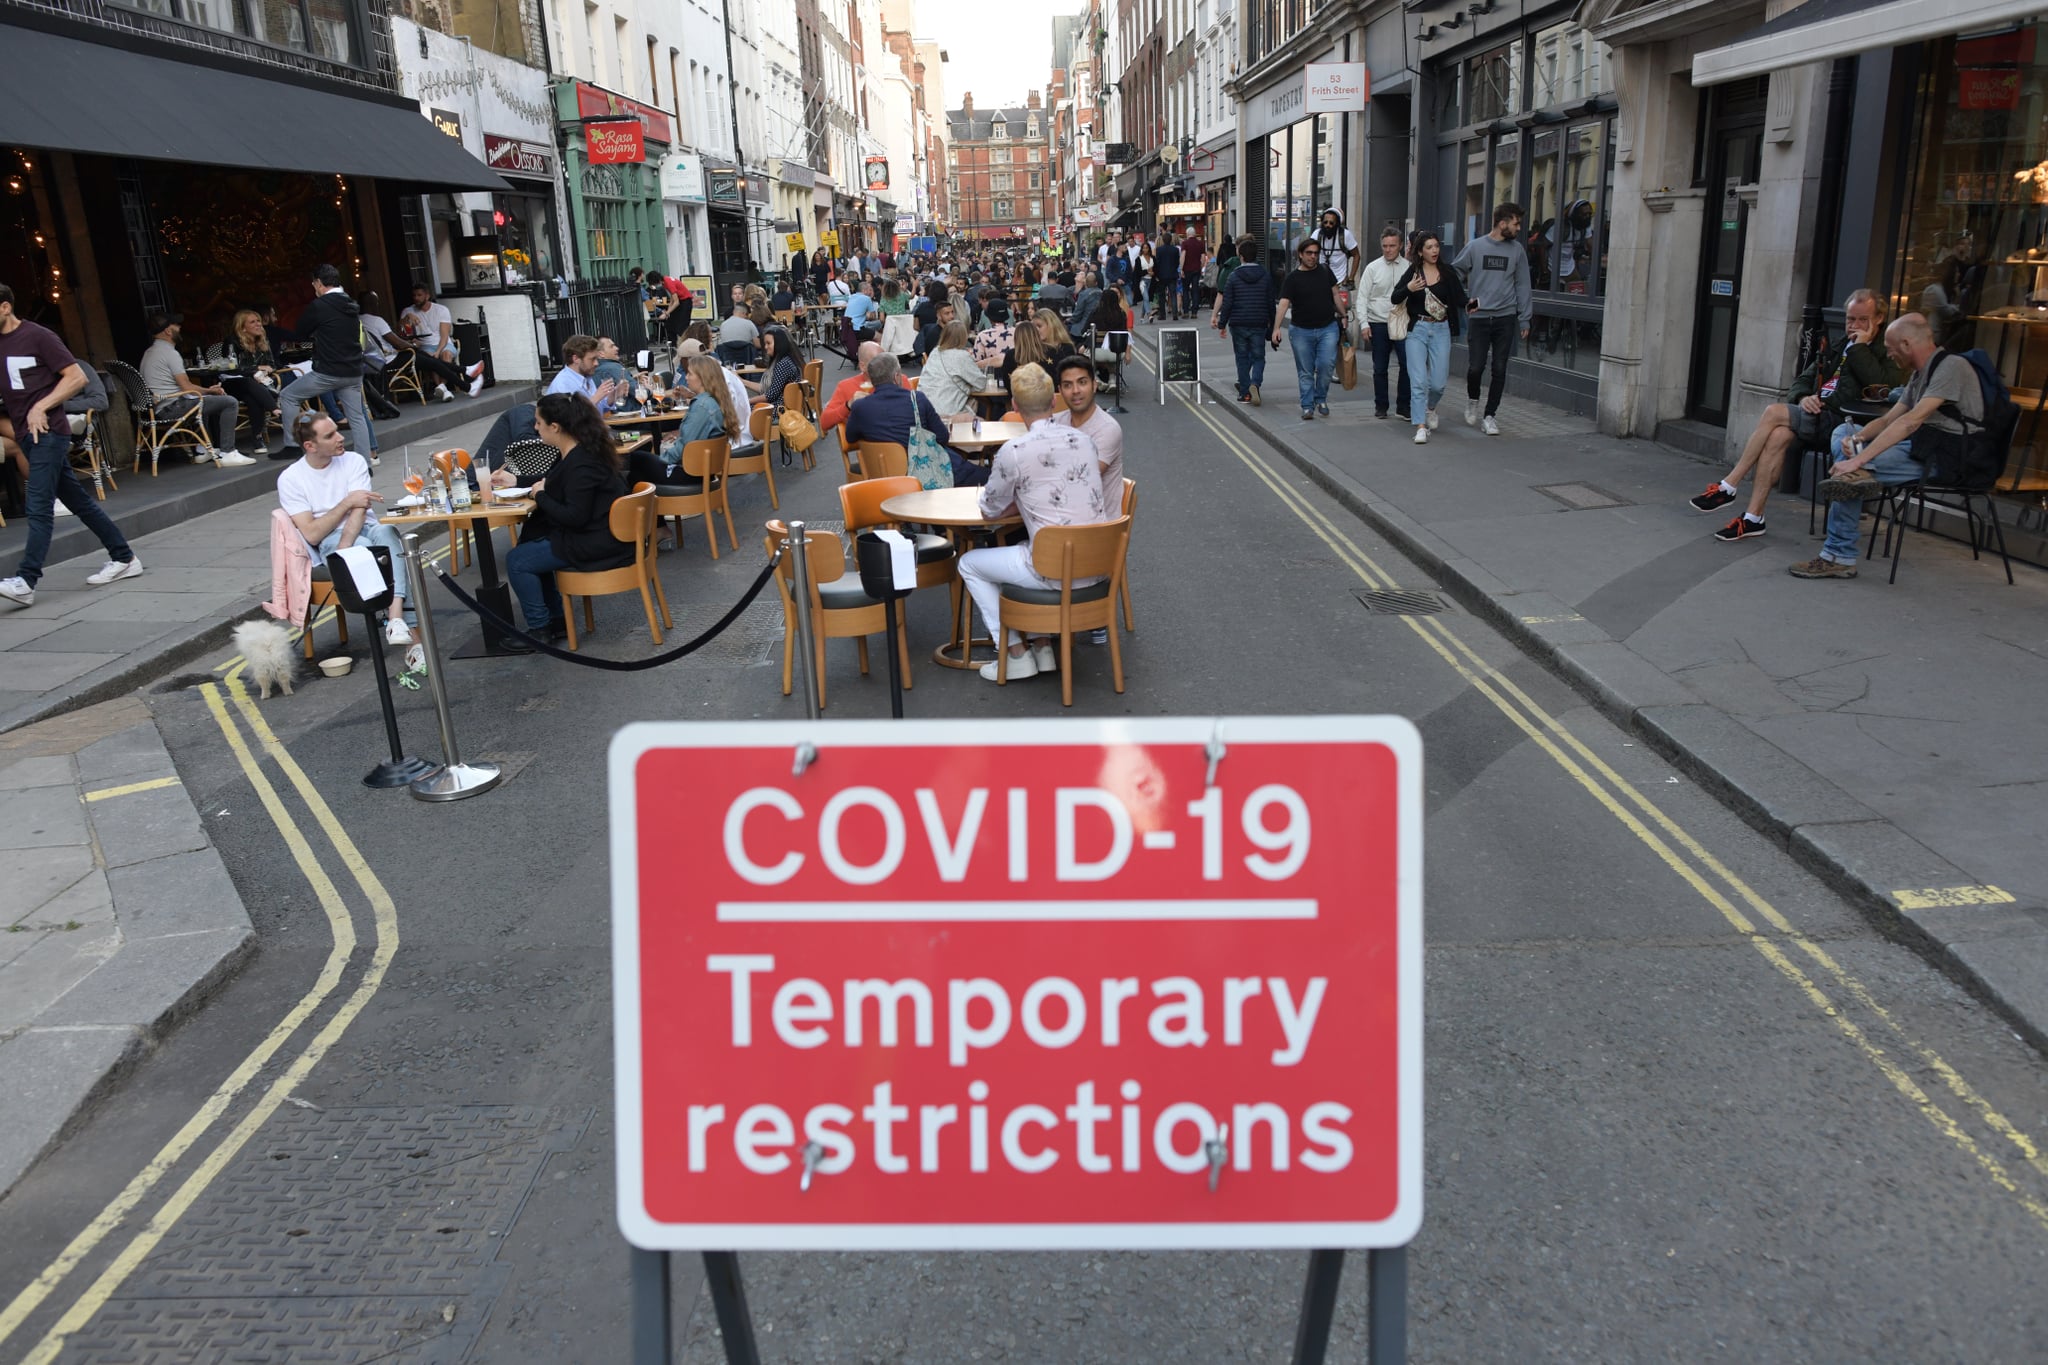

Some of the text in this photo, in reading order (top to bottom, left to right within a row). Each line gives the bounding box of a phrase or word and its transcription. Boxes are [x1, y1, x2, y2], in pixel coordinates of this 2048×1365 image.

[1311, 85, 1359, 95] Frith Street
[1330, 74, 1341, 83] 53
[1271, 85, 1303, 118] TAPESTRY
[605, 130, 633, 144] Rasa
[596, 141, 637, 160] Sayang
[722, 784, 1312, 886] COVID-19
[706, 954, 1328, 1067] Temporary
[686, 1079, 1354, 1174] restrictions
